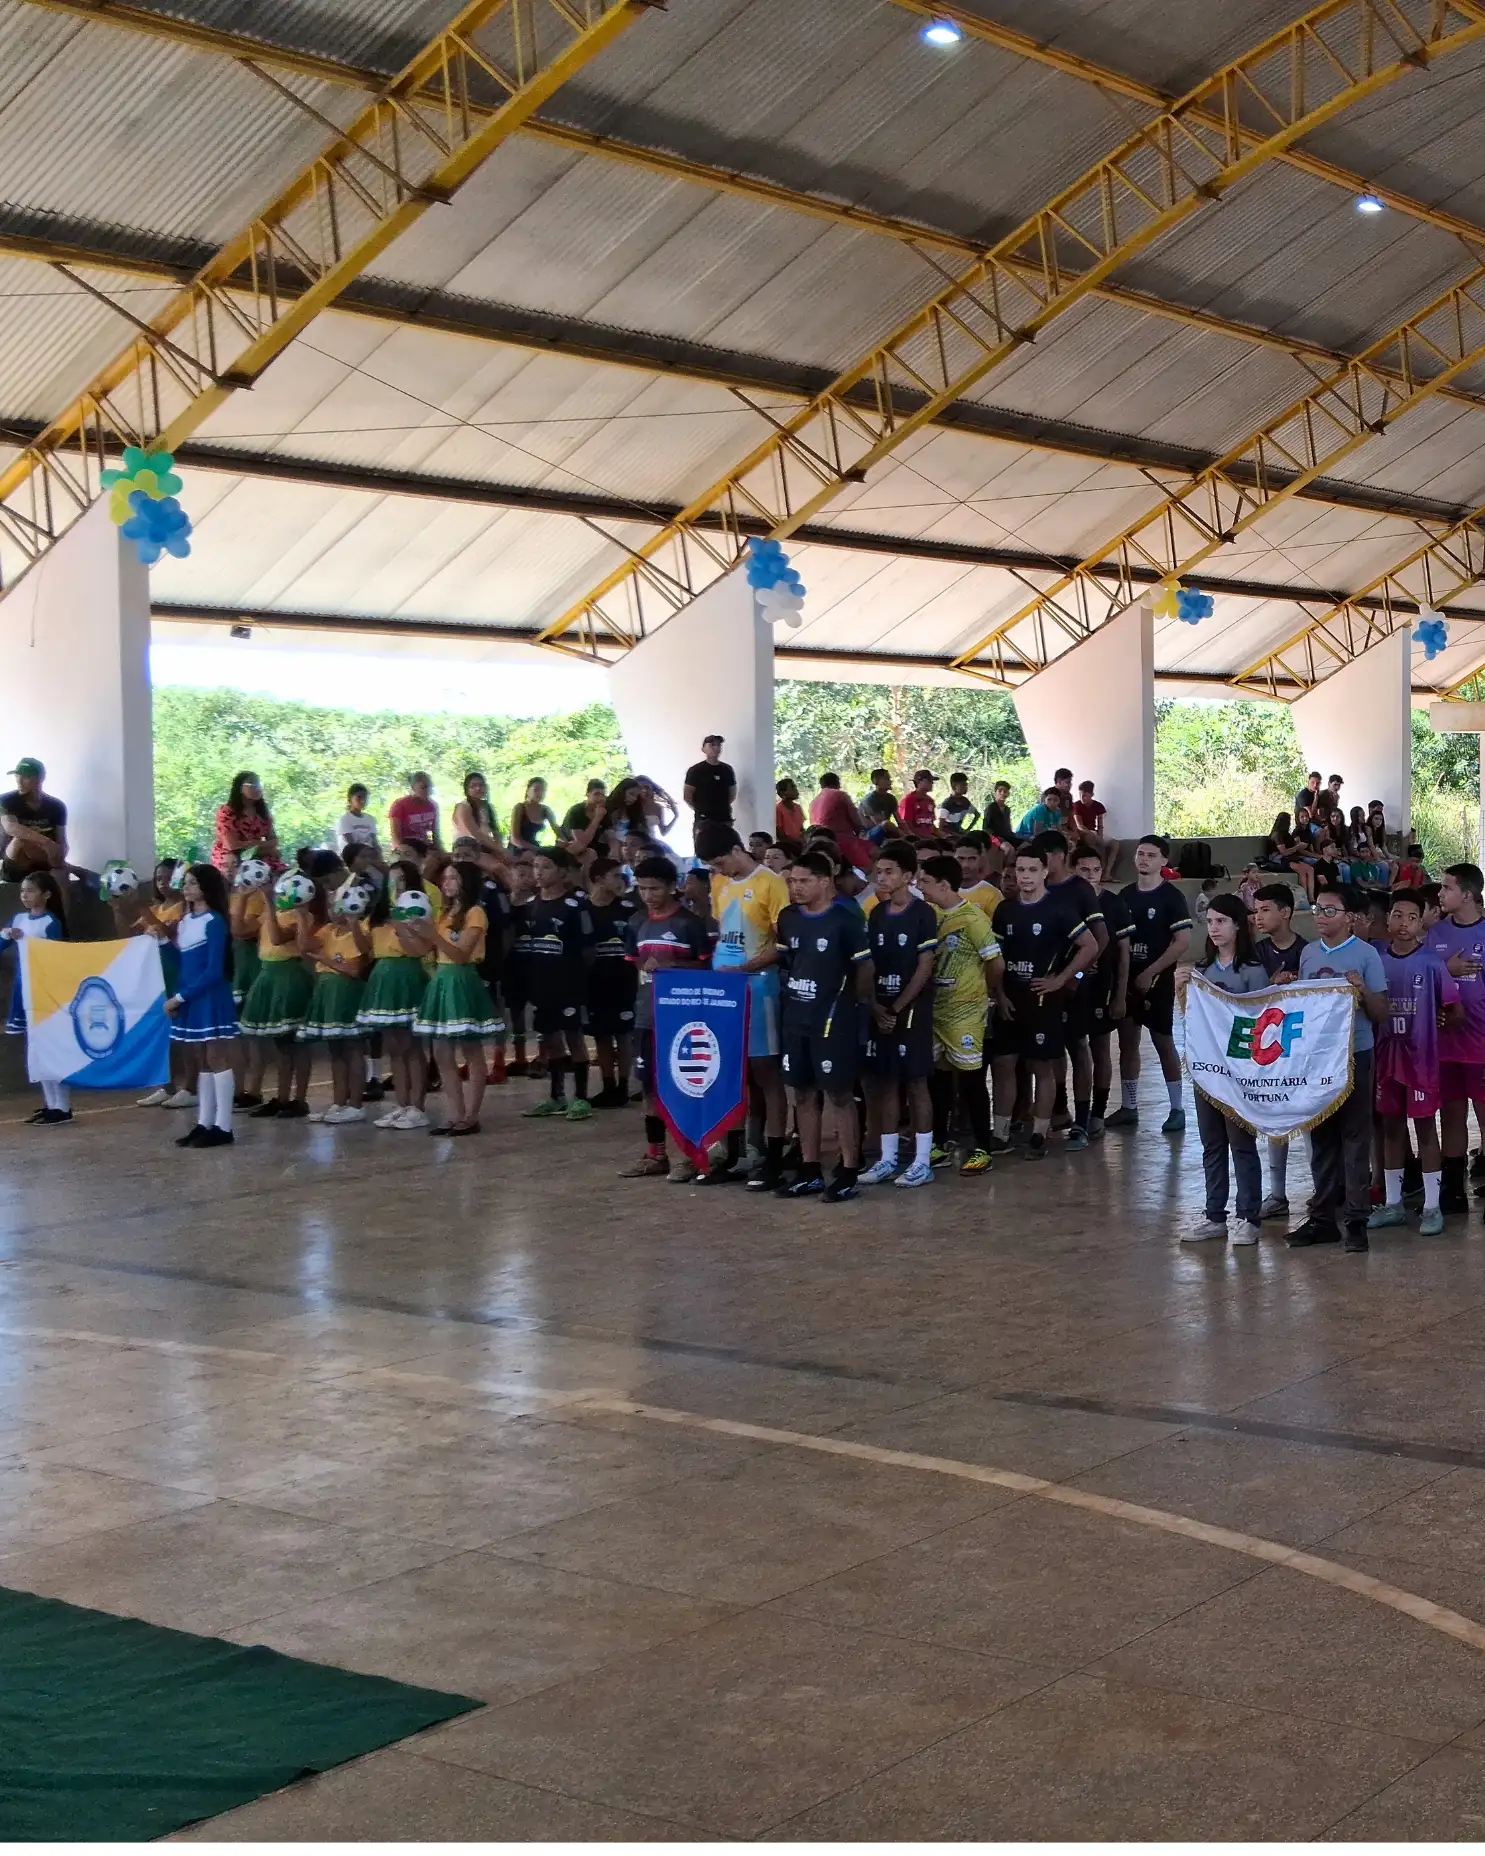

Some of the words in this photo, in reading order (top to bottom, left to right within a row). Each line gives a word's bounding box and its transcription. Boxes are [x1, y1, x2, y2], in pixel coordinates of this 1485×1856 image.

[1226, 1007, 1304, 1066] ECF
[1392, 1016, 1406, 1034] 10
[1192, 1062, 1232, 1078] ESCOLA
[1320, 1075, 1334, 1086] DE
